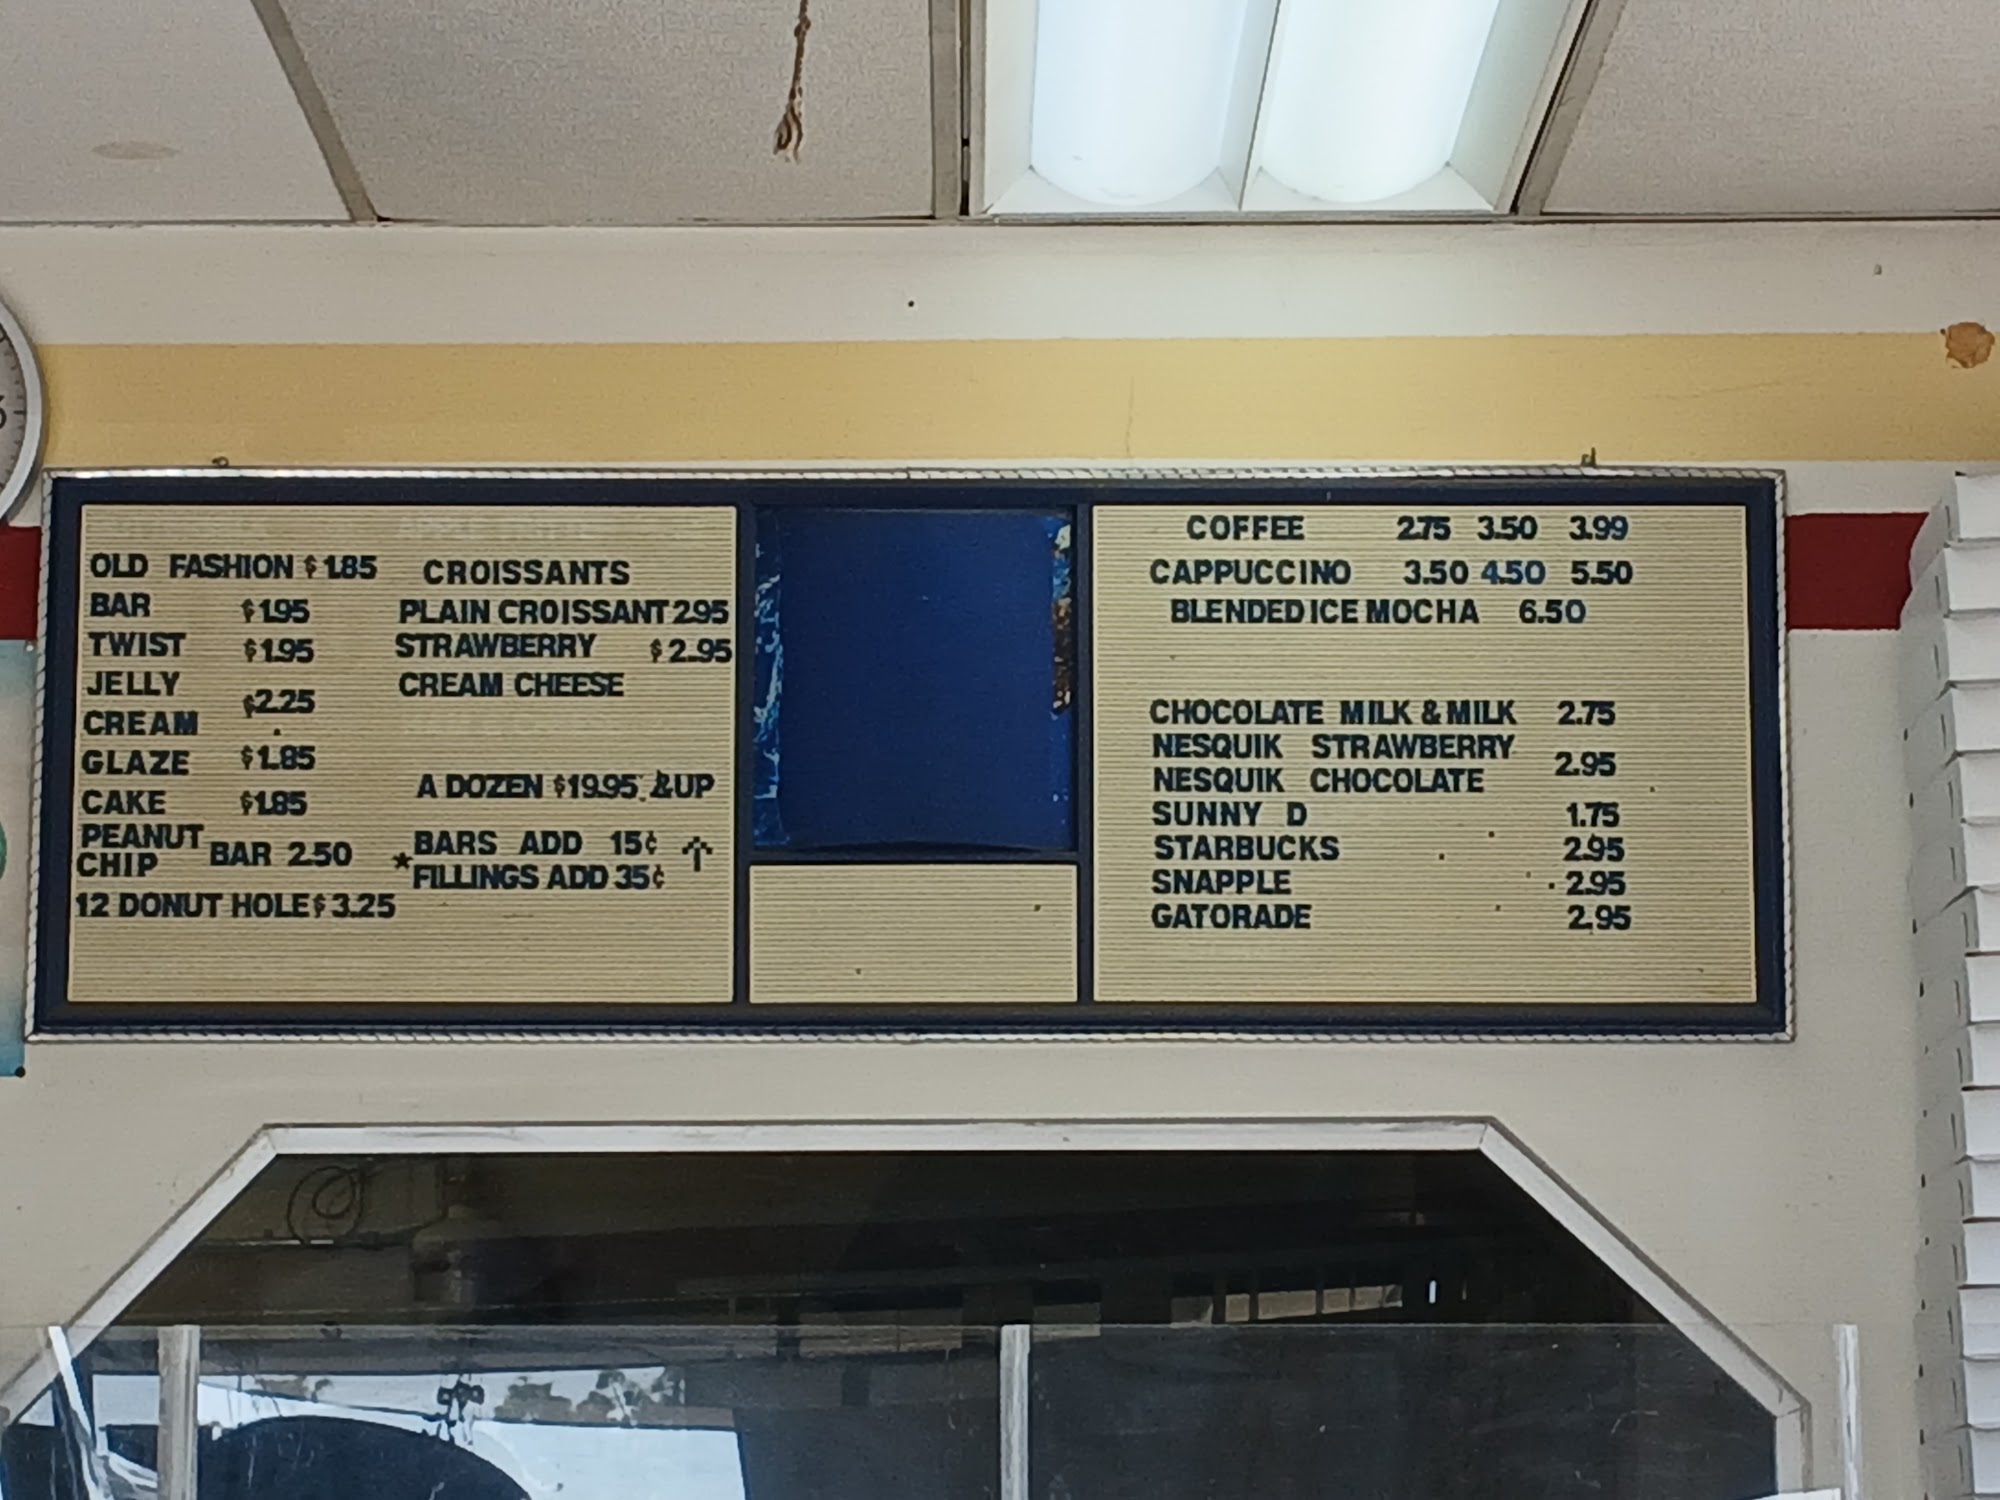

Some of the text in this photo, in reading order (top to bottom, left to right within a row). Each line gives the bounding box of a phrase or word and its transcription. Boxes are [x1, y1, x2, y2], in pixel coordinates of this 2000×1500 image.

[1187, 515, 1305, 541] COFFEE
[1477, 515, 1538, 541] 3.50
[1569, 515, 1629, 541] 3.99
[89, 552, 149, 579] OLD
[169, 553, 294, 580] FASHION
[423, 559, 630, 586] CROISSANTS
[1150, 558, 1634, 586] CAPPUCCINO 3.50 4.50 5.50
[89, 591, 151, 618] BAR
[398, 598, 491, 625] PLAIN
[497, 599, 670, 625] CROISSANT
[1171, 598, 1587, 625] BLENDED ICE MOCHA 6.50
[87, 630, 187, 658] TWIST
[395, 632, 598, 659] STRAWBERRY
[86, 670, 181, 697] JELLY
[398, 671, 625, 698] CREAM CHEESE
[83, 709, 199, 736] CREAM
[1149, 698, 1324, 725] CHOCOLATE
[1339, 699, 1413, 726] MILK
[1446, 699, 1518, 726] MILK
[1557, 700, 1616, 727] 2.75
[1152, 733, 1515, 760] NESQUIK STRAWBERRY
[81, 749, 190, 776] GLAZE
[1554, 751, 1617, 777] 2.95
[416, 773, 438, 799] A
[445, 773, 544, 799] DOZEN
[1153, 766, 1485, 794] NESQUIK CHOCOLATE
[81, 789, 167, 816] CAKE
[1152, 800, 1620, 828] SUNNY D 1.75
[81, 823, 205, 850] PEANUT
[413, 830, 498, 856] BARS
[518, 830, 583, 856] ADD
[1154, 834, 1625, 863] STARBUCKS 2.95
[76, 851, 159, 878] CHIP
[209, 840, 272, 867] BAR
[412, 863, 540, 890] FILLINGS
[546, 863, 610, 890] ADD
[1152, 868, 1626, 897] SNAPPLE 2.95
[75, 891, 110, 918] 12
[118, 891, 224, 919] DONUT
[231, 892, 310, 919] HOLE
[1151, 903, 1632, 931] GATORADE 2.95
